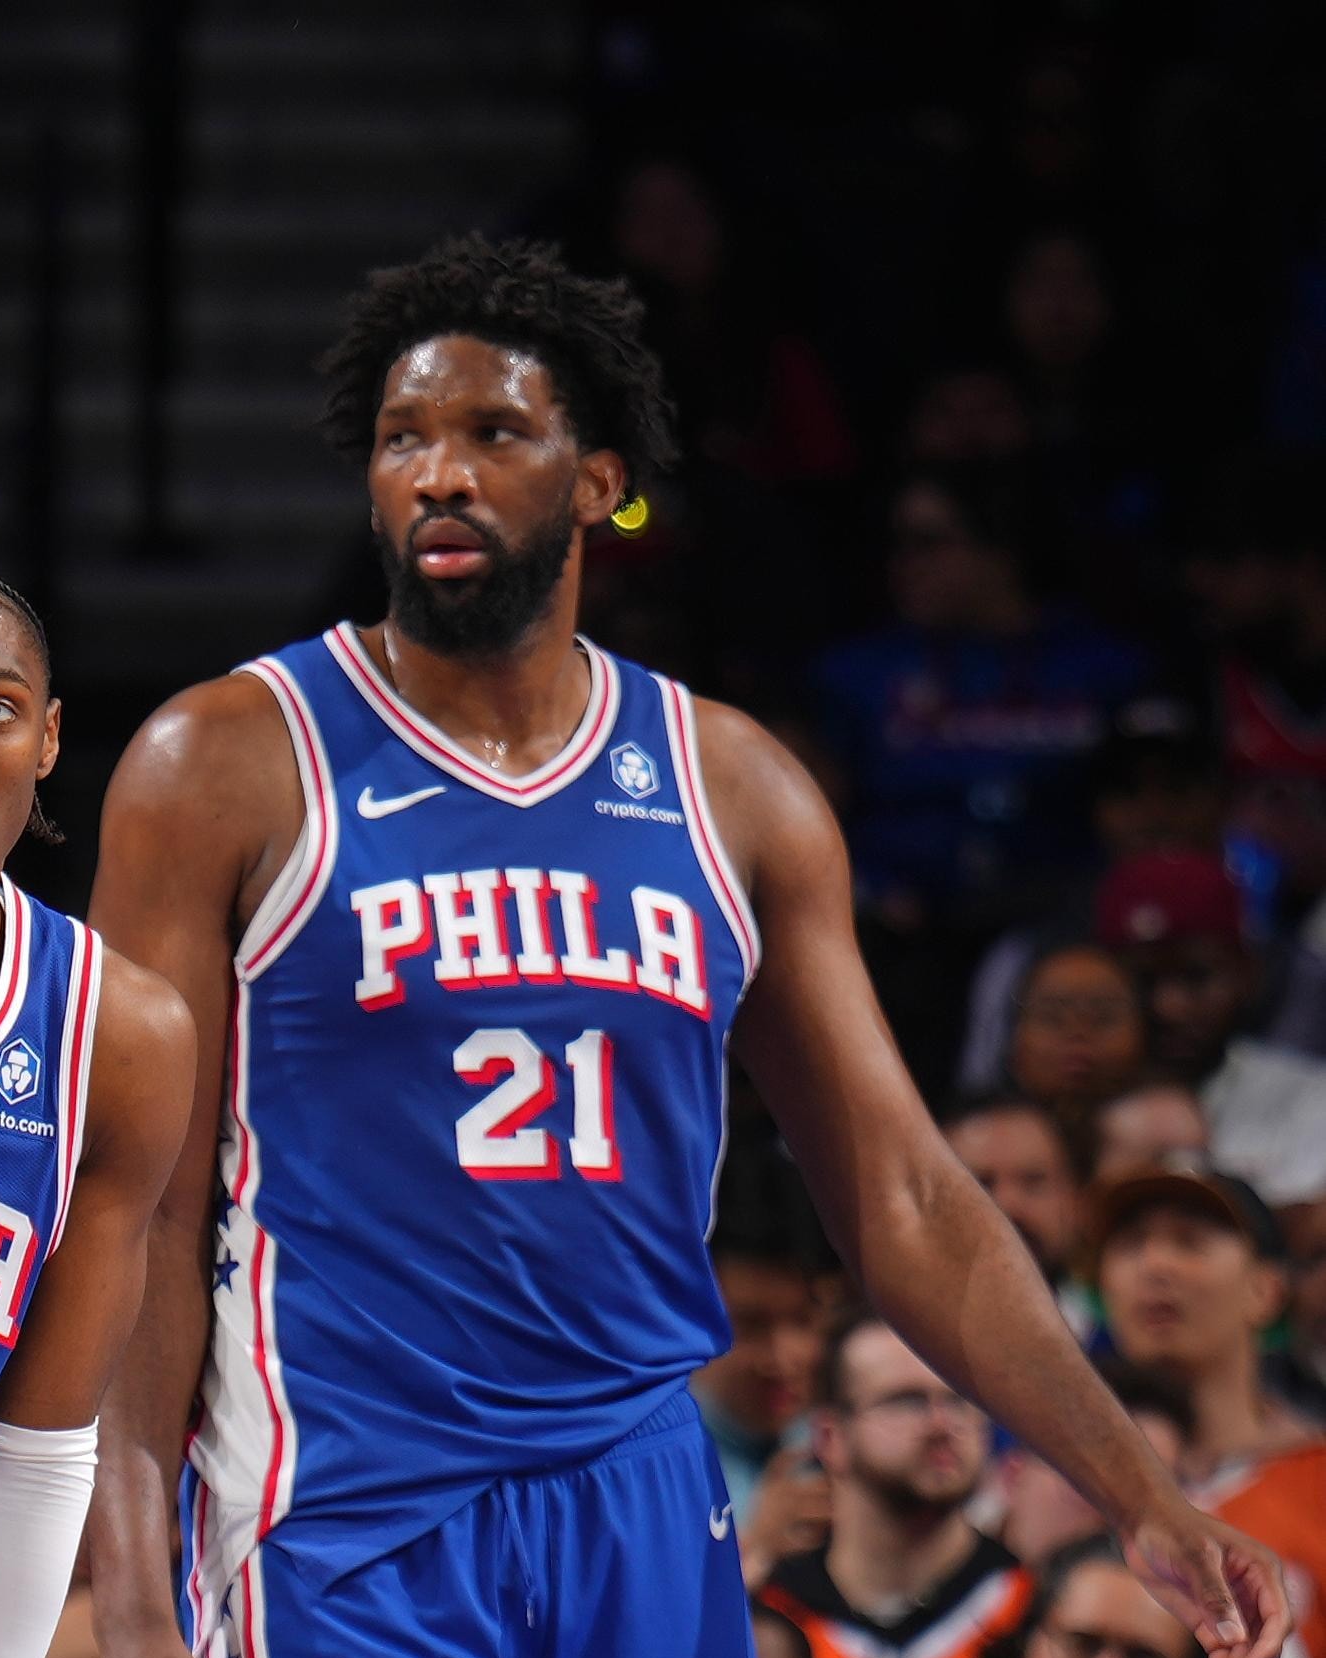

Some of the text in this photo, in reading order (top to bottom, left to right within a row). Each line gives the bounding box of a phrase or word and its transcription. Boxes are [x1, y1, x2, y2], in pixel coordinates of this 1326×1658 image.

[594, 800, 685, 825] crypto.com
[350, 868, 713, 1023] PHILA
[452, 1027, 623, 1181] 21
